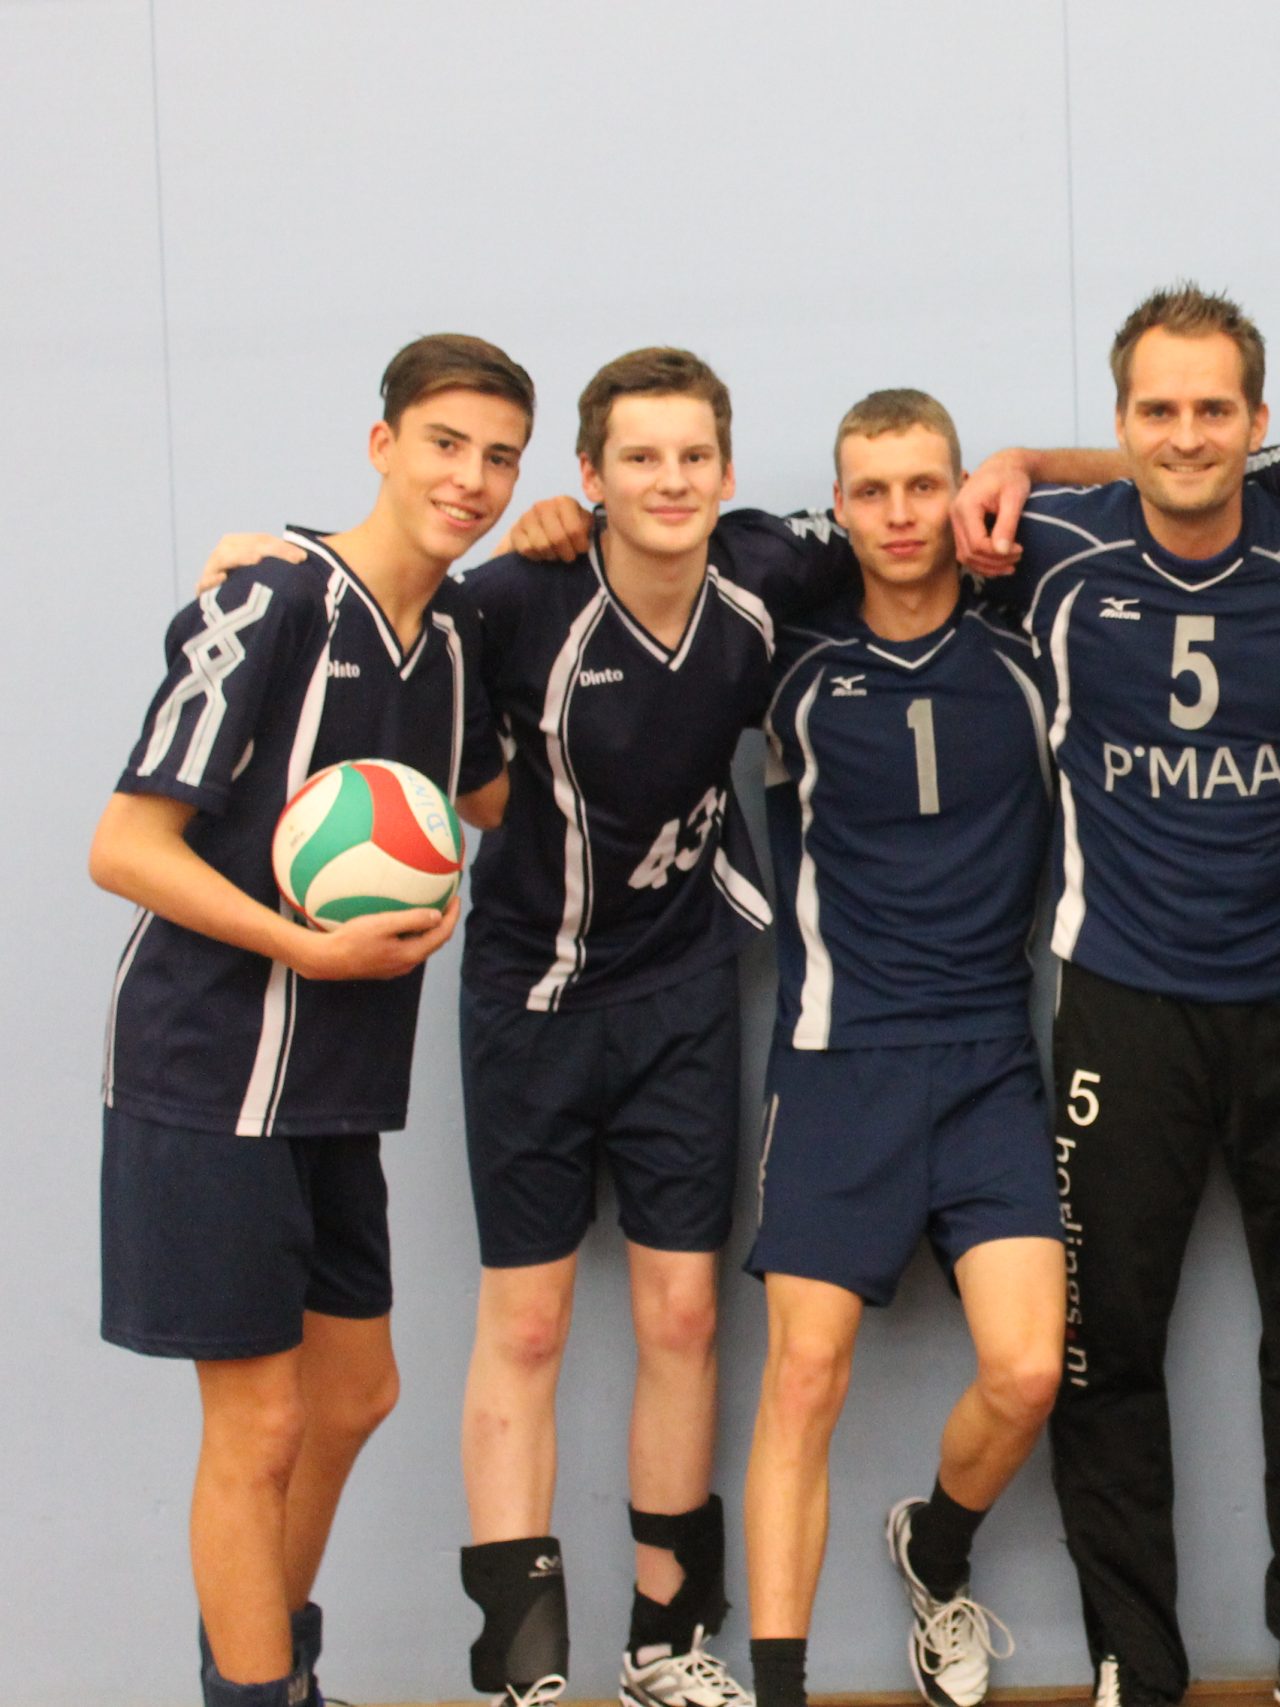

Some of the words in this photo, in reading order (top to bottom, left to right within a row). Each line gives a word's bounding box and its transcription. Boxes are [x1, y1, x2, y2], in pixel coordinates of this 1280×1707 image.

[326, 659, 361, 679] Dinto
[579, 667, 624, 688] Dinto
[1169, 615, 1220, 730] 5
[906, 698, 939, 814] 1
[627, 786, 727, 889] 43
[1067, 1069, 1101, 1126] 5
